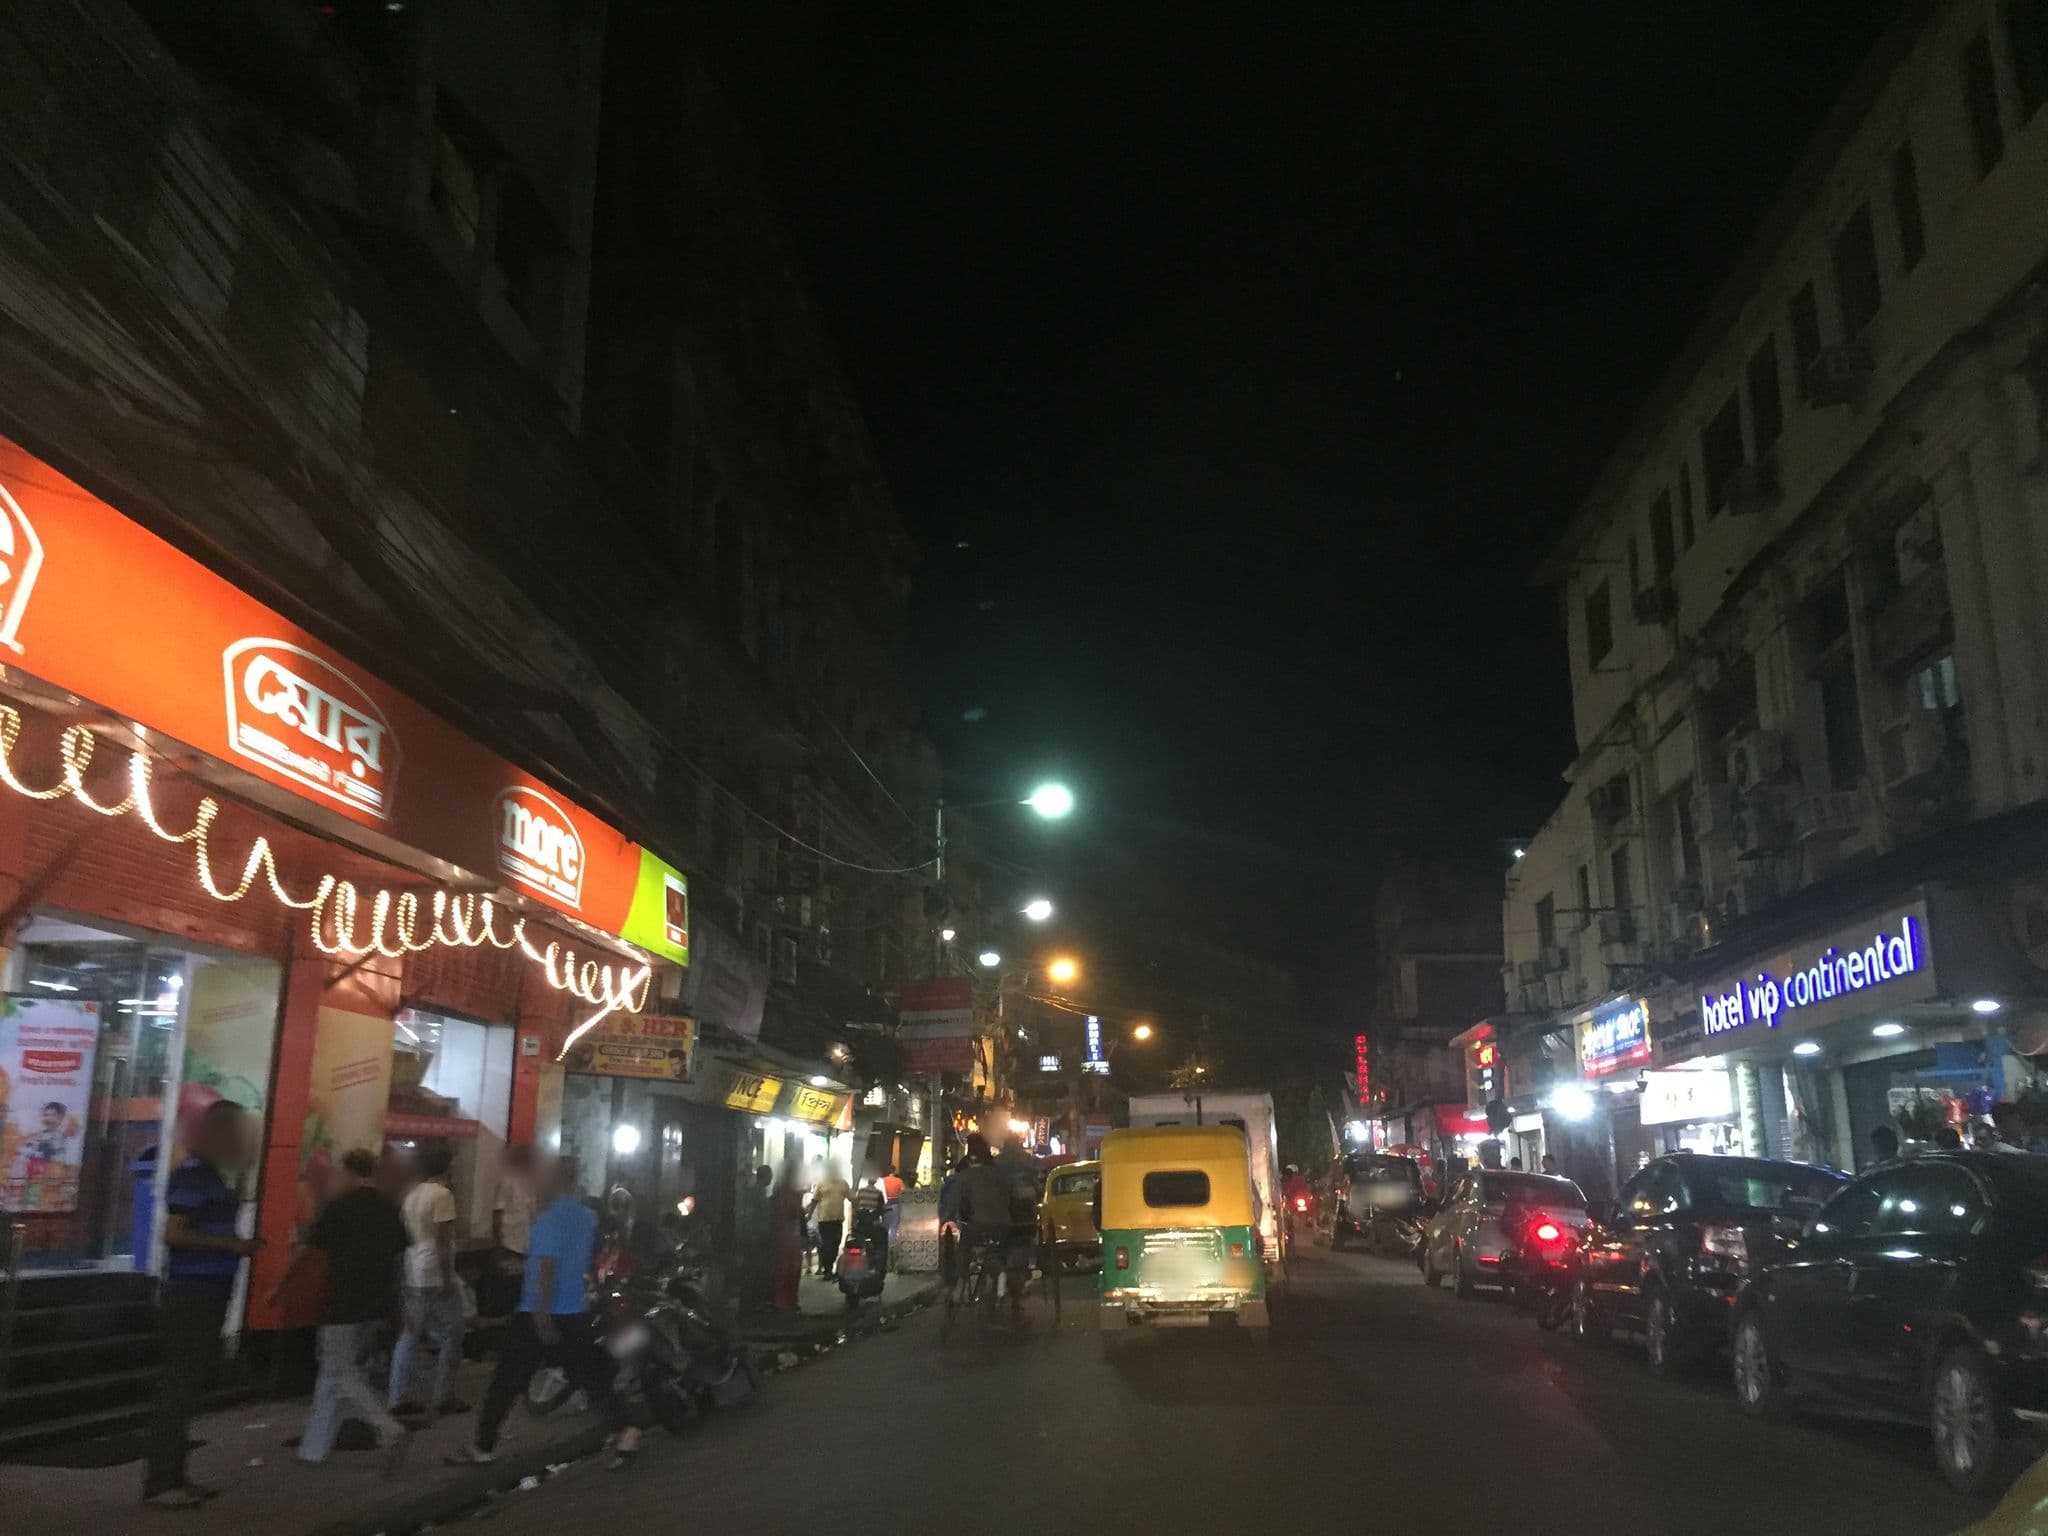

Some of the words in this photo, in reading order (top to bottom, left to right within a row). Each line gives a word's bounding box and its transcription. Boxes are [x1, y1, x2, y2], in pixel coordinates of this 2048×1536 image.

[244, 655, 387, 777] মোর
[502, 799, 578, 881] more
[1701, 981, 1745, 1036] hotel
[1748, 973, 1780, 1028] vip
[1784, 916, 1916, 1008] continental
